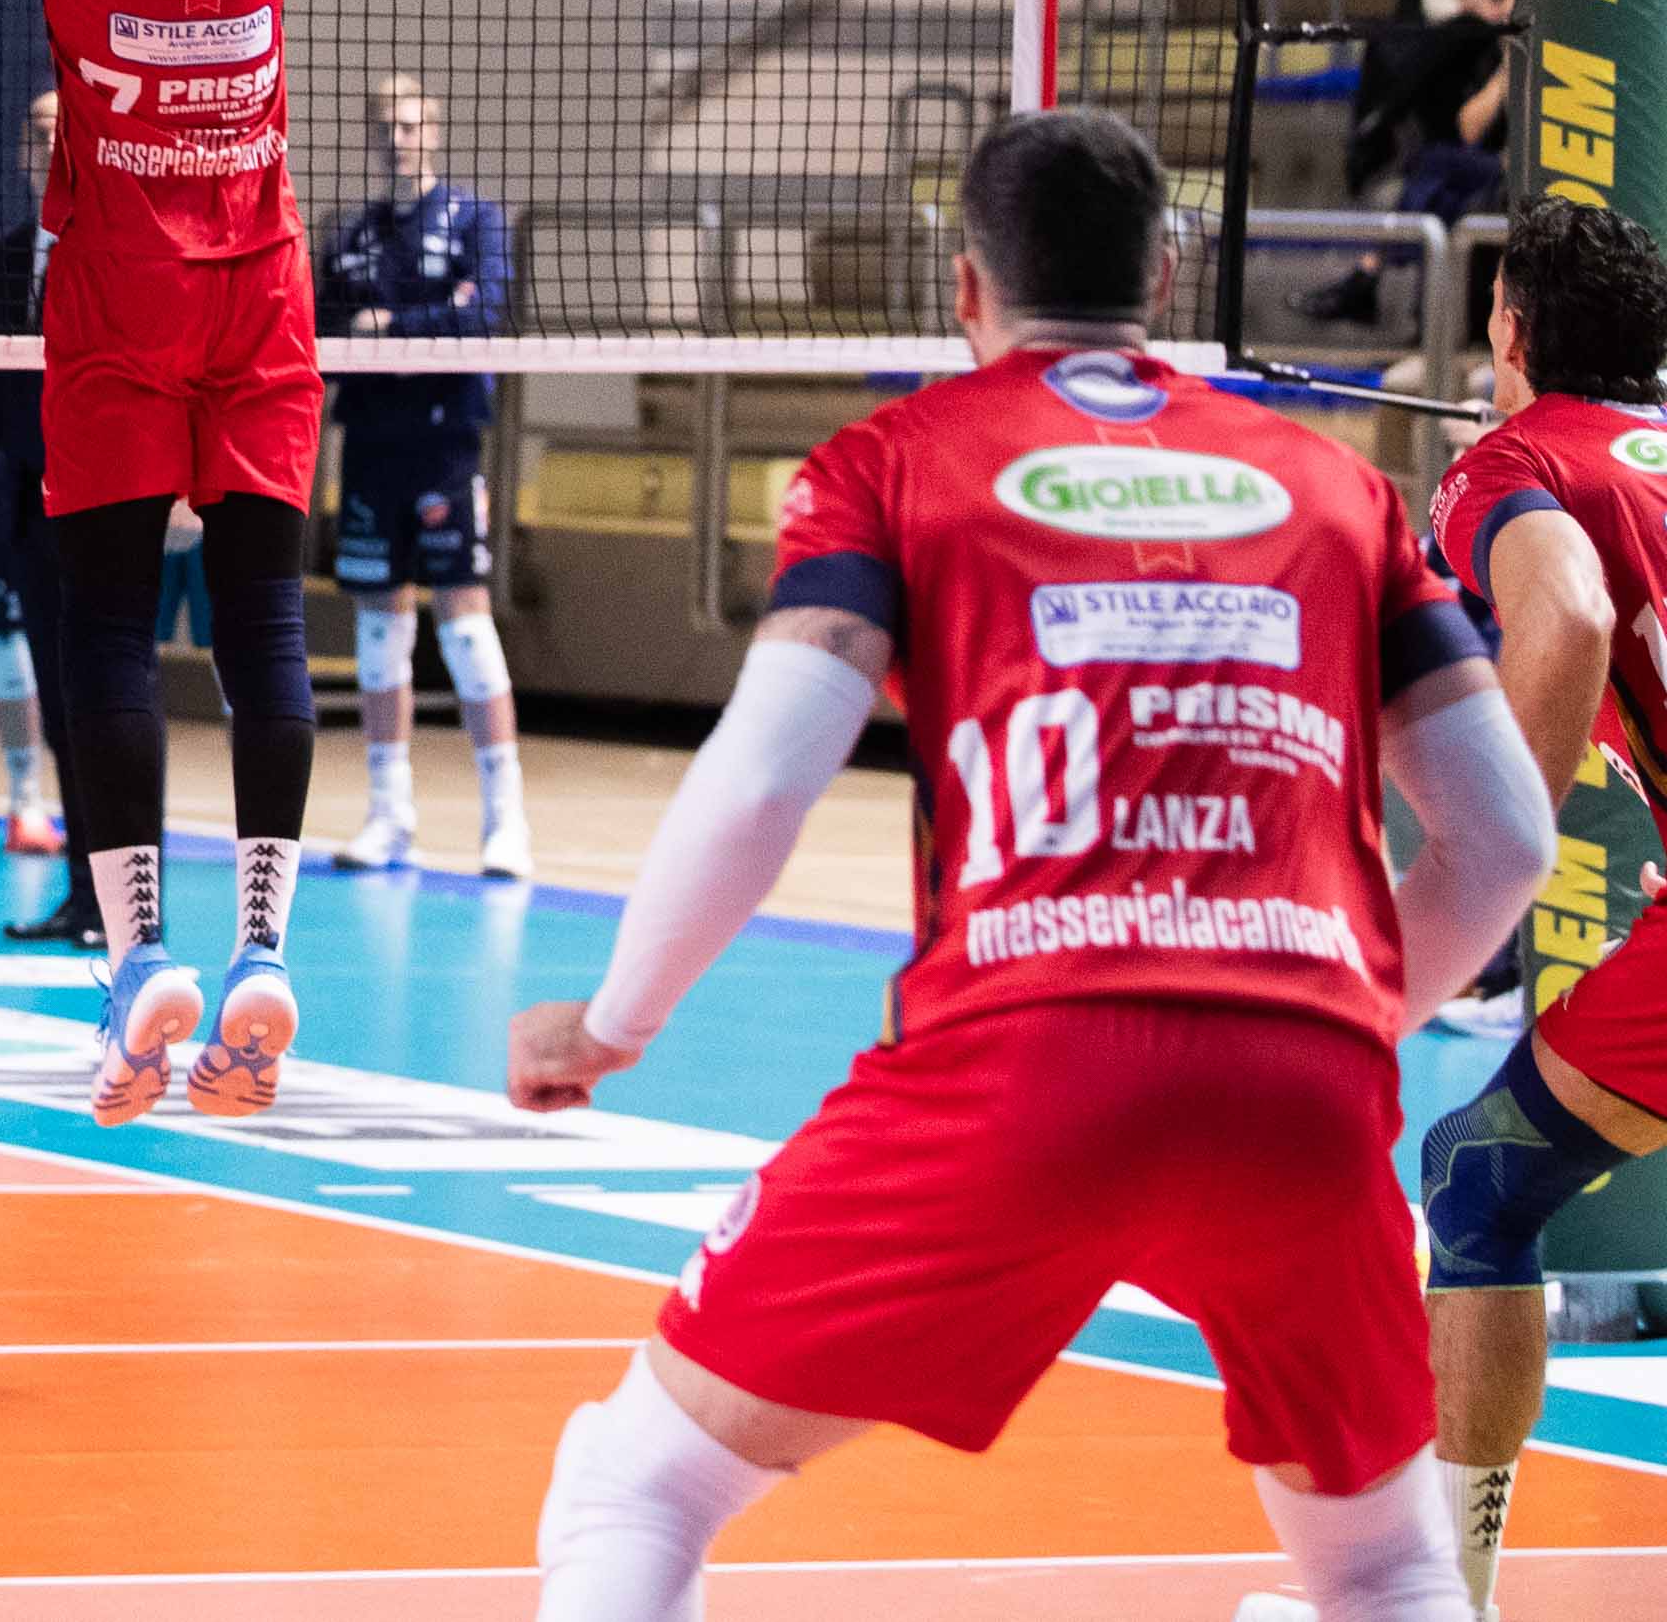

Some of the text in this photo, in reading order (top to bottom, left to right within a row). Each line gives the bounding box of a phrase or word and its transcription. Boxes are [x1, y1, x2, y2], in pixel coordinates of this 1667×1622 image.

[142, 10, 270, 39] STILE ACCIAIO
[77, 56, 143, 115] 7
[159, 46, 279, 104] PRISM
[1020, 463, 1263, 513] GIOIELLA
[1084, 589, 1292, 620] STILE ACCIAIO
[1128, 681, 1345, 768] PRISMA
[947, 687, 1102, 890] 10
[1110, 793, 1257, 855] LANZA
